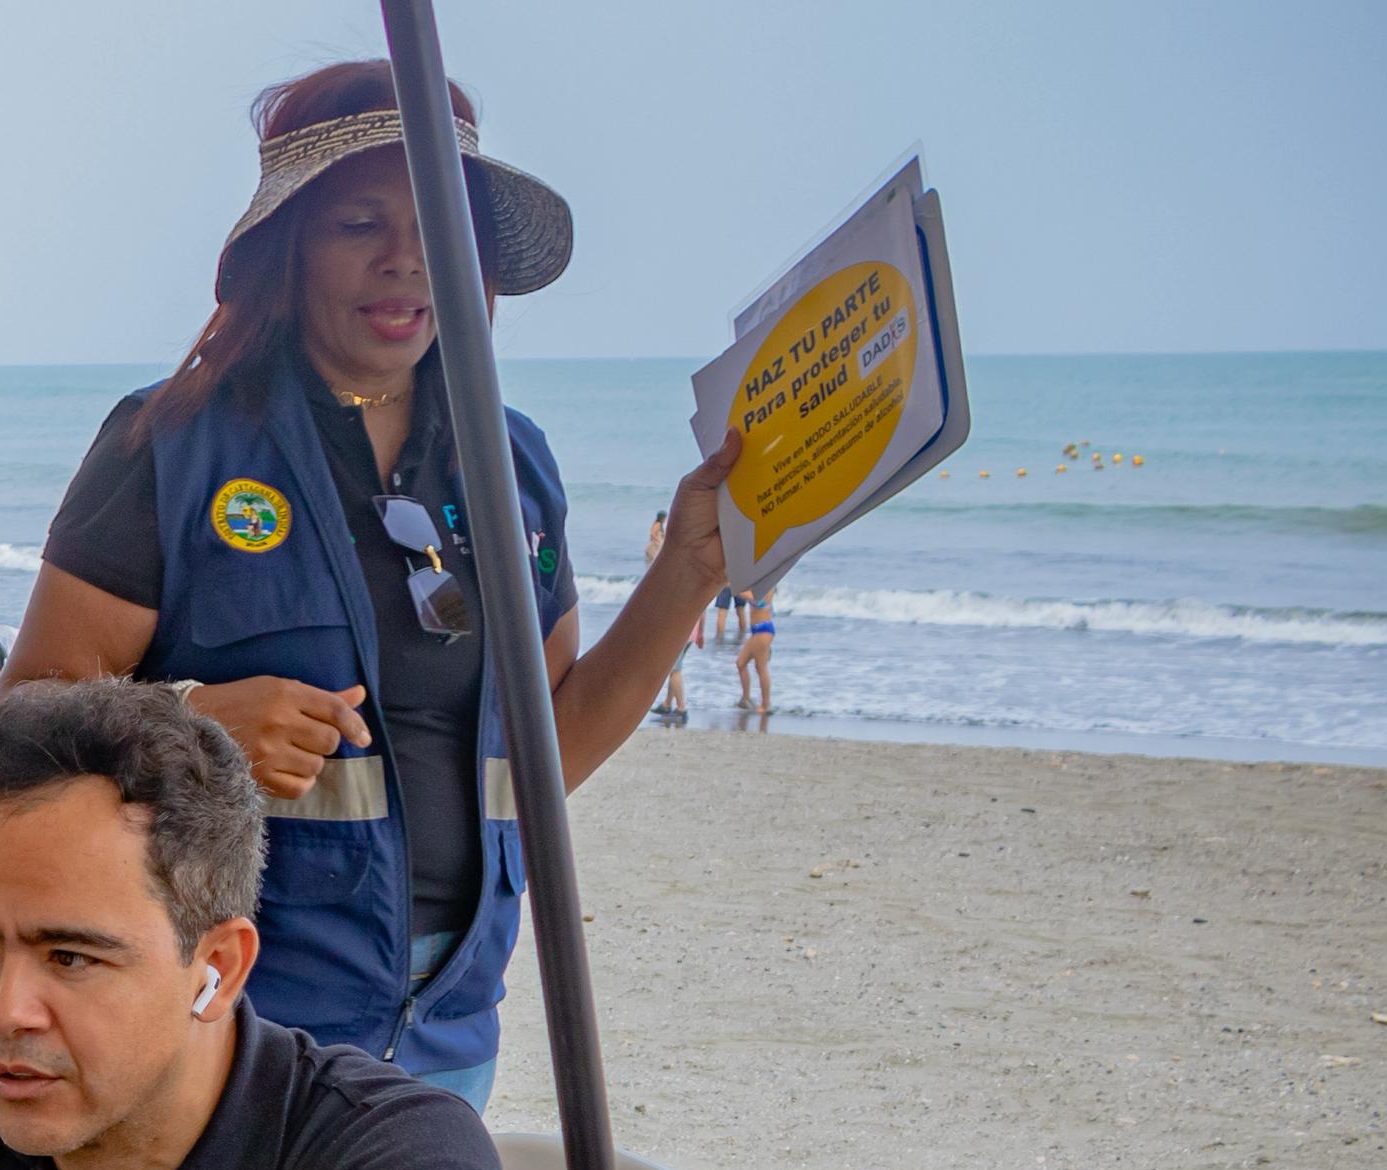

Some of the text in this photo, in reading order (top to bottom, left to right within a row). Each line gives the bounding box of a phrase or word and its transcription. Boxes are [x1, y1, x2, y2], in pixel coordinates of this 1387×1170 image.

[743, 296, 891, 433] Para proteger tu
[745, 271, 881, 402] HAZ TU PARTE
[773, 374, 884, 474] Vive en MODO SALUDABLE
[799, 363, 848, 418] salud
[756, 487, 772, 504] haz
[760, 501, 774, 517] NO
[826, 431, 863, 466] consumo
[864, 420, 875, 433] de
